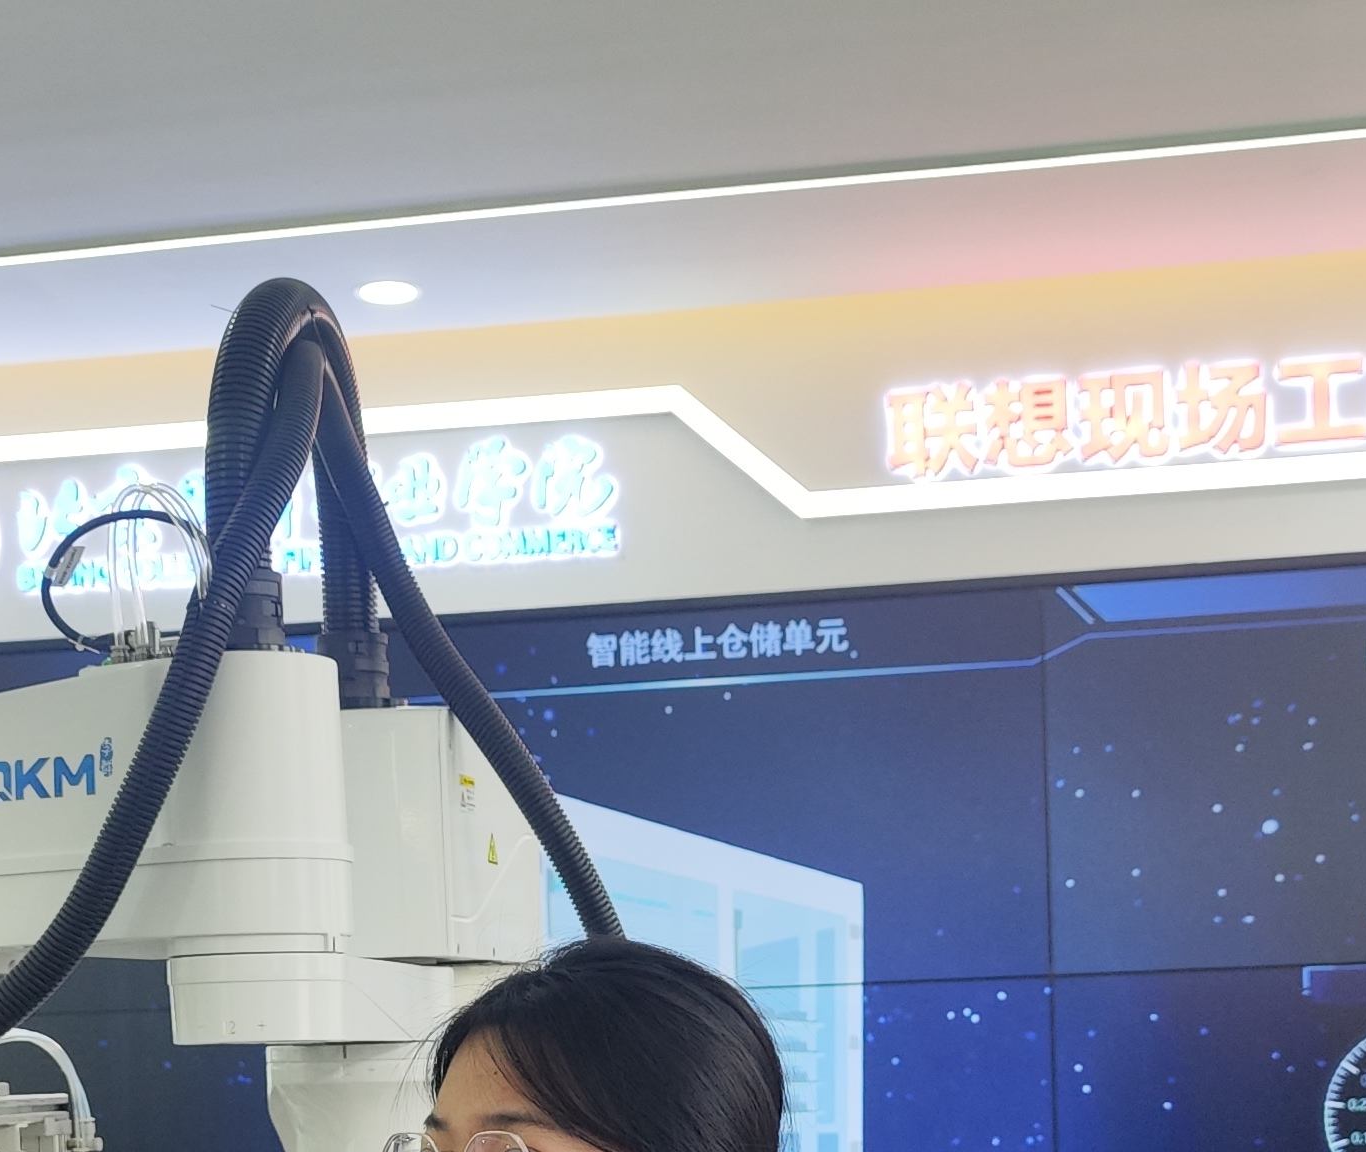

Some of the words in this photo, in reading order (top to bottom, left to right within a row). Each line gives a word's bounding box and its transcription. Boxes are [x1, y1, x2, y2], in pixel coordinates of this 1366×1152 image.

[586, 617, 849, 669] 智能线上仓储单元
